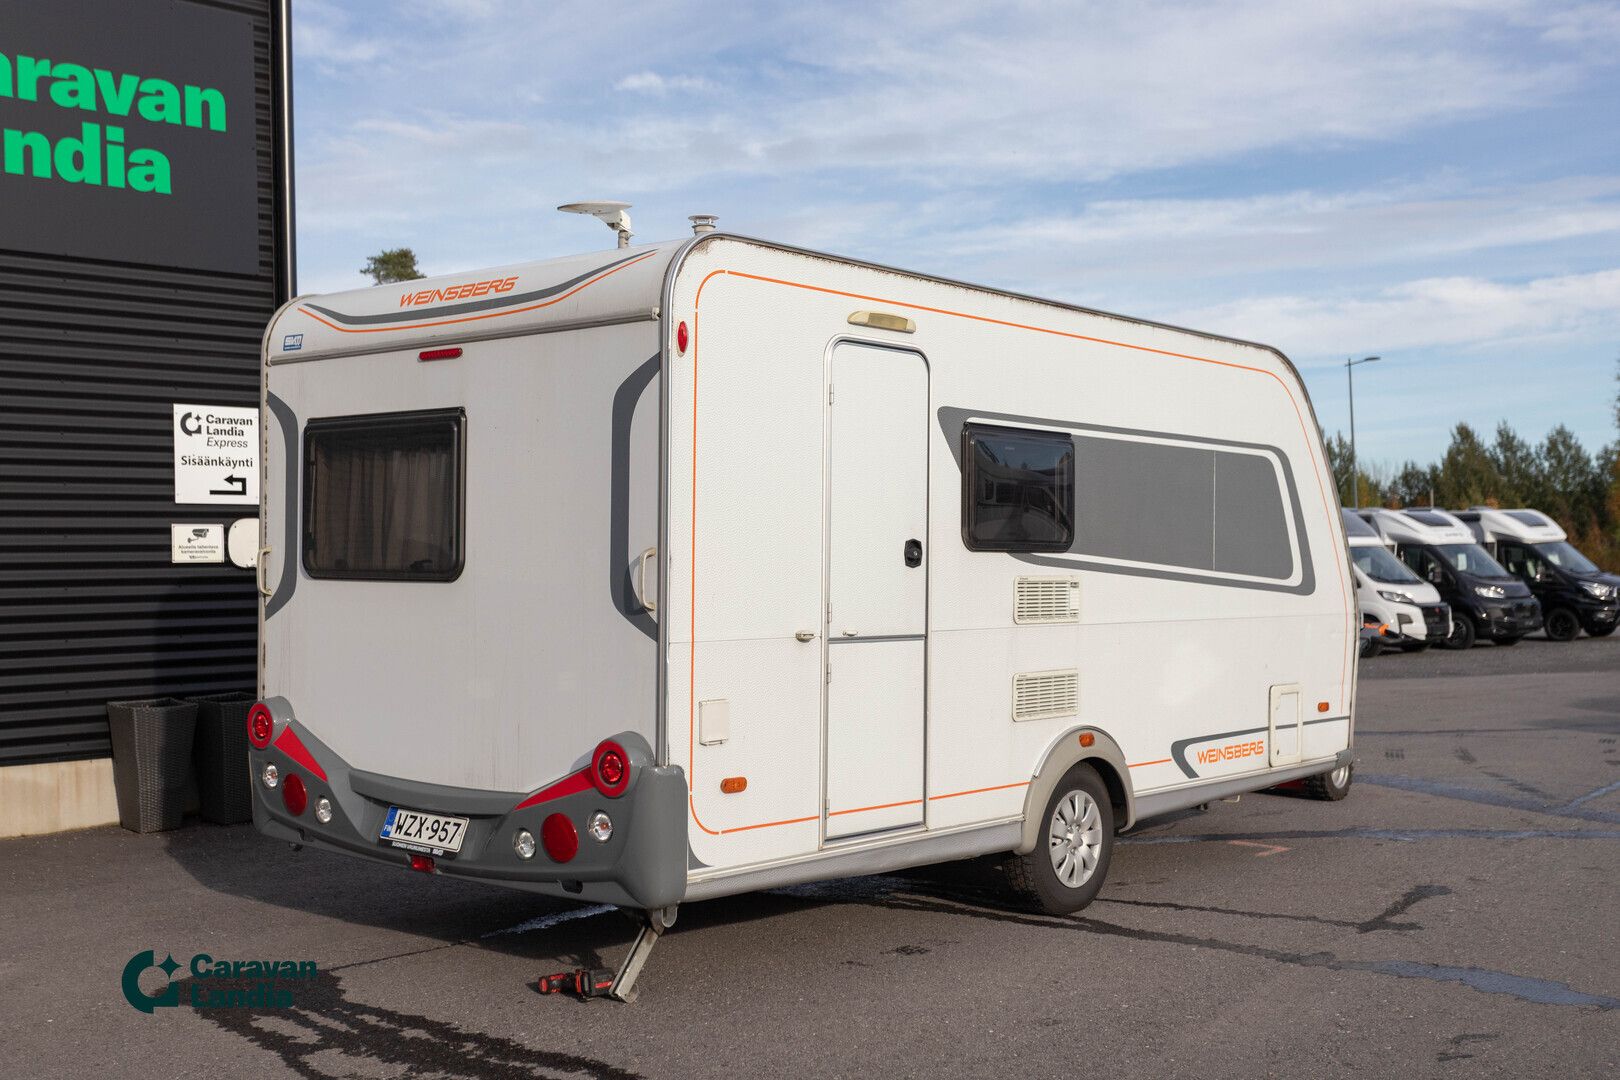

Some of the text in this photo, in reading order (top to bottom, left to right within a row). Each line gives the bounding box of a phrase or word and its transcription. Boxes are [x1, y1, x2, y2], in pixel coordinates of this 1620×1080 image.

[0, 51, 227, 132] ravan
[400, 276, 519, 307] WEINSBERG
[205, 414, 253, 426] Caravan
[206, 425, 245, 437] Landia
[206, 436, 248, 449] Express
[181, 455, 254, 469] Sisäänkäynti
[1197, 741, 1264, 764] WEINSBERG
[394, 813, 462, 844] WZX-957
